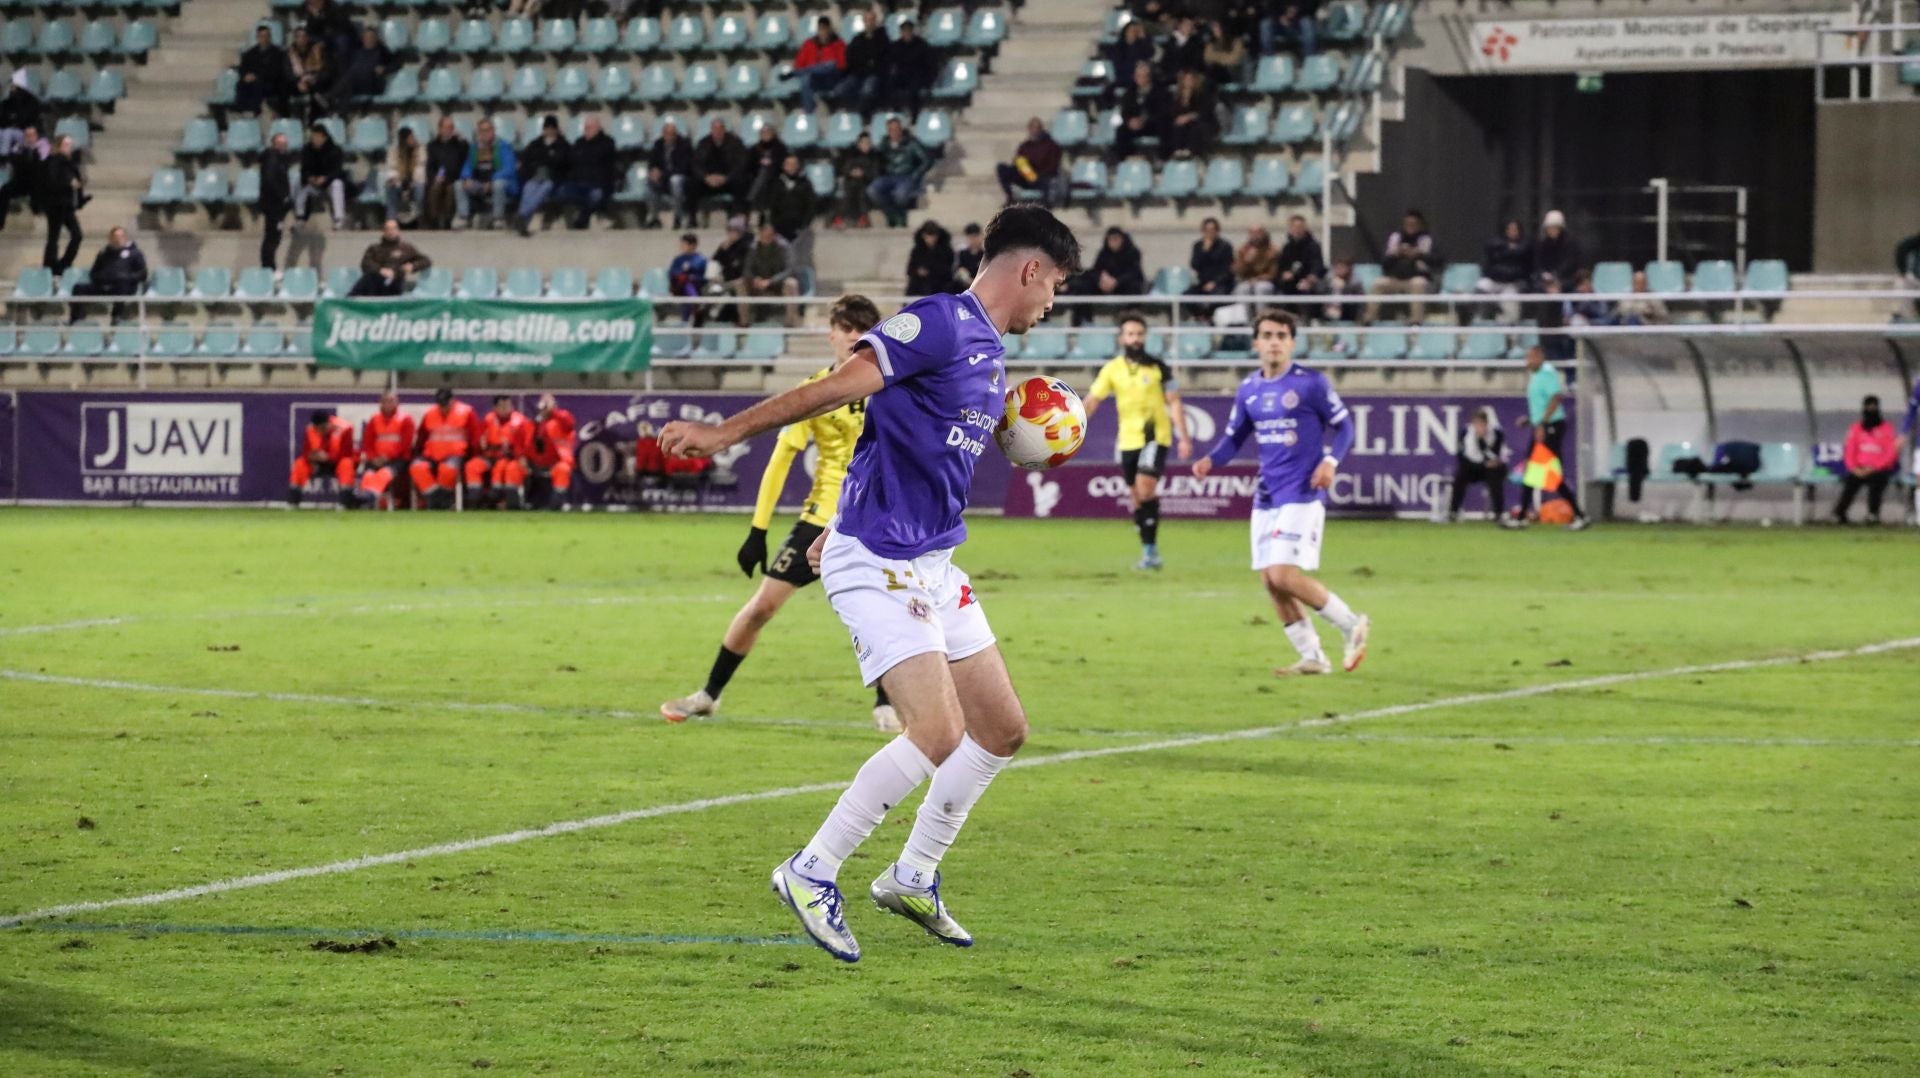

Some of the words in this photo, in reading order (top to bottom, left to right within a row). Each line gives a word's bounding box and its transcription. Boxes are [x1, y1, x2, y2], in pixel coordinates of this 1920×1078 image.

[1529, 21, 1617, 38] Patronato
[1624, 18, 1707, 37] Municipal
[1716, 20, 1738, 34] de
[1575, 45, 1684, 61] Ayuntamiento
[1693, 44, 1711, 56] de
[325, 310, 636, 347] jardineriacastilla.com
[579, 398, 670, 442] CAFÉ
[680, 403, 730, 425] BA
[133, 419, 230, 456] JAVI
[83, 477, 114, 494] BAR
[118, 477, 240, 495] RESTAURANTE
